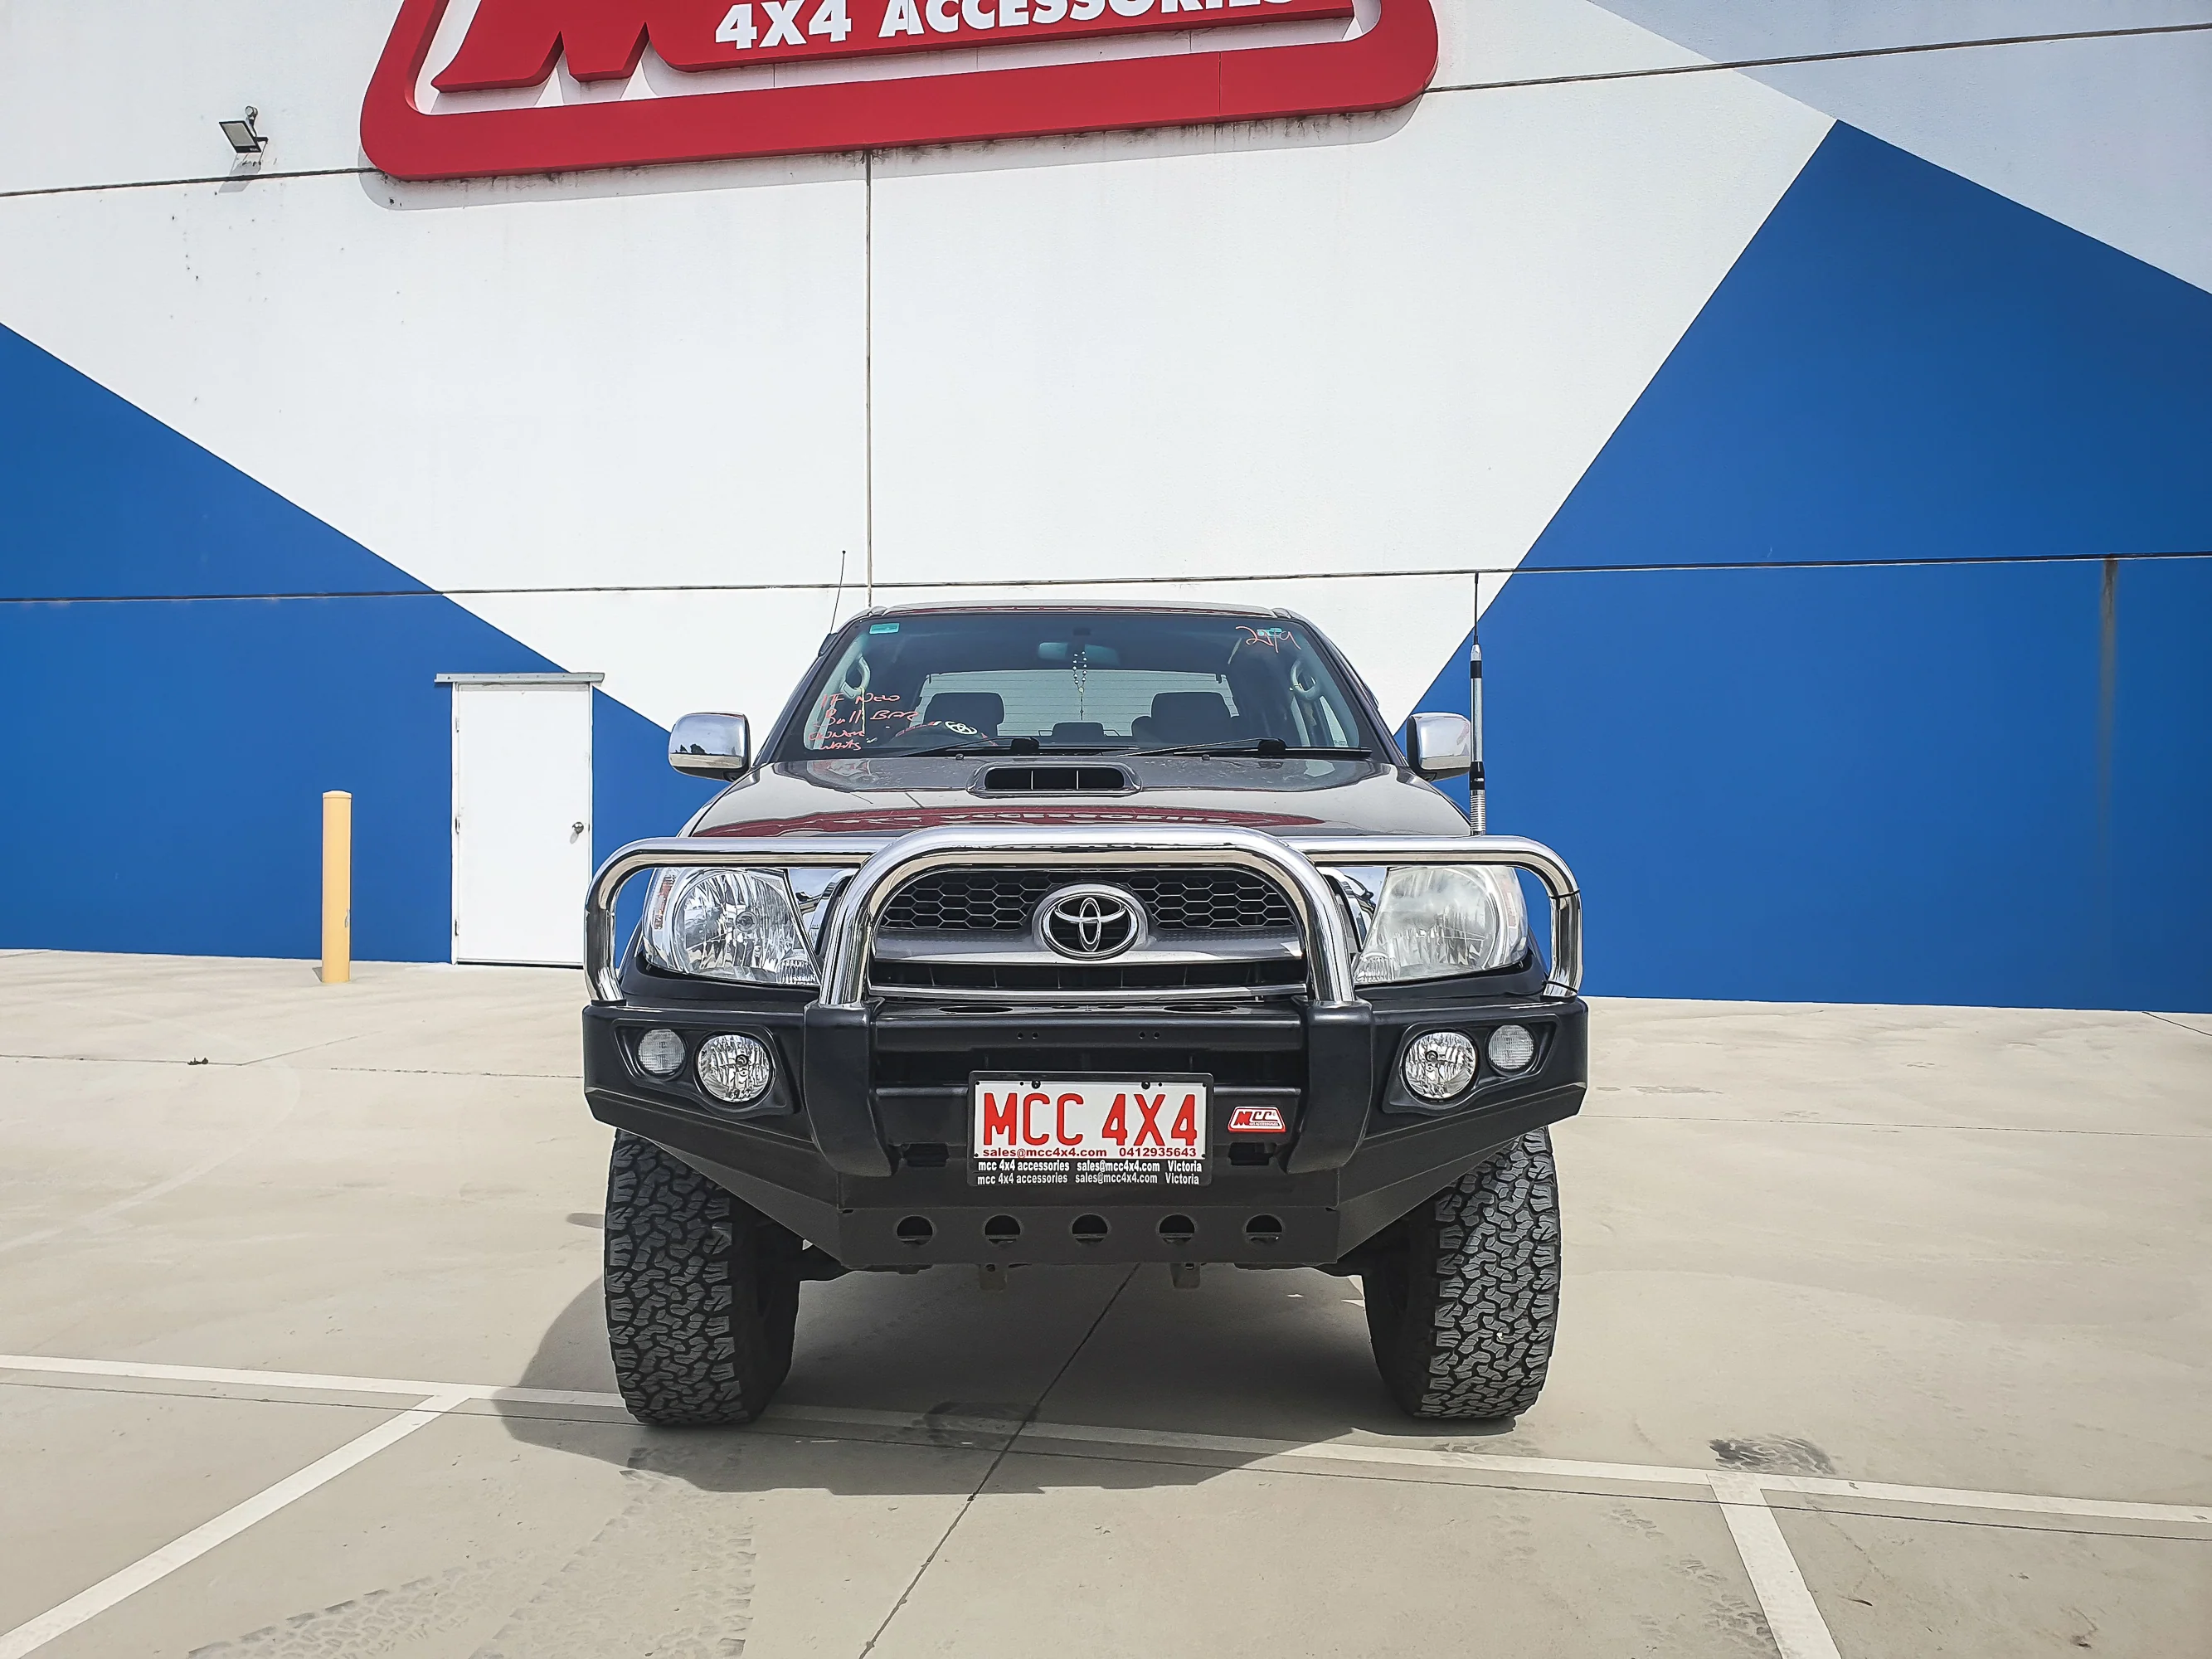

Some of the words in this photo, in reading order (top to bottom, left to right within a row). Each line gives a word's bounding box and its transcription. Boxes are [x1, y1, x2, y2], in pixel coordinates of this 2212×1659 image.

[715, 0, 851, 50] 4X4
[878, 0, 1292, 38] ACCESS
[984, 1092, 1084, 1146] MCC
[1101, 1093, 1198, 1146] 4X4
[983, 1147, 1107, 1158] sales@mcc4x4.com
[1119, 1147, 1197, 1157] 0412935643
[978, 1162, 997, 1171] mcc
[999, 1160, 1015, 1170] 4x4
[1017, 1160, 1070, 1171] accessories
[1077, 1160, 1160, 1172] sales@mcc4x4.com
[1168, 1160, 1202, 1172] Victoria
[977, 1175, 995, 1185] mcc
[998, 1173, 1014, 1184] 4x4
[1016, 1172, 1068, 1184] accessories
[1075, 1172, 1158, 1184] sales@mcc4x4.com
[1164, 1172, 1199, 1185] Victoria
